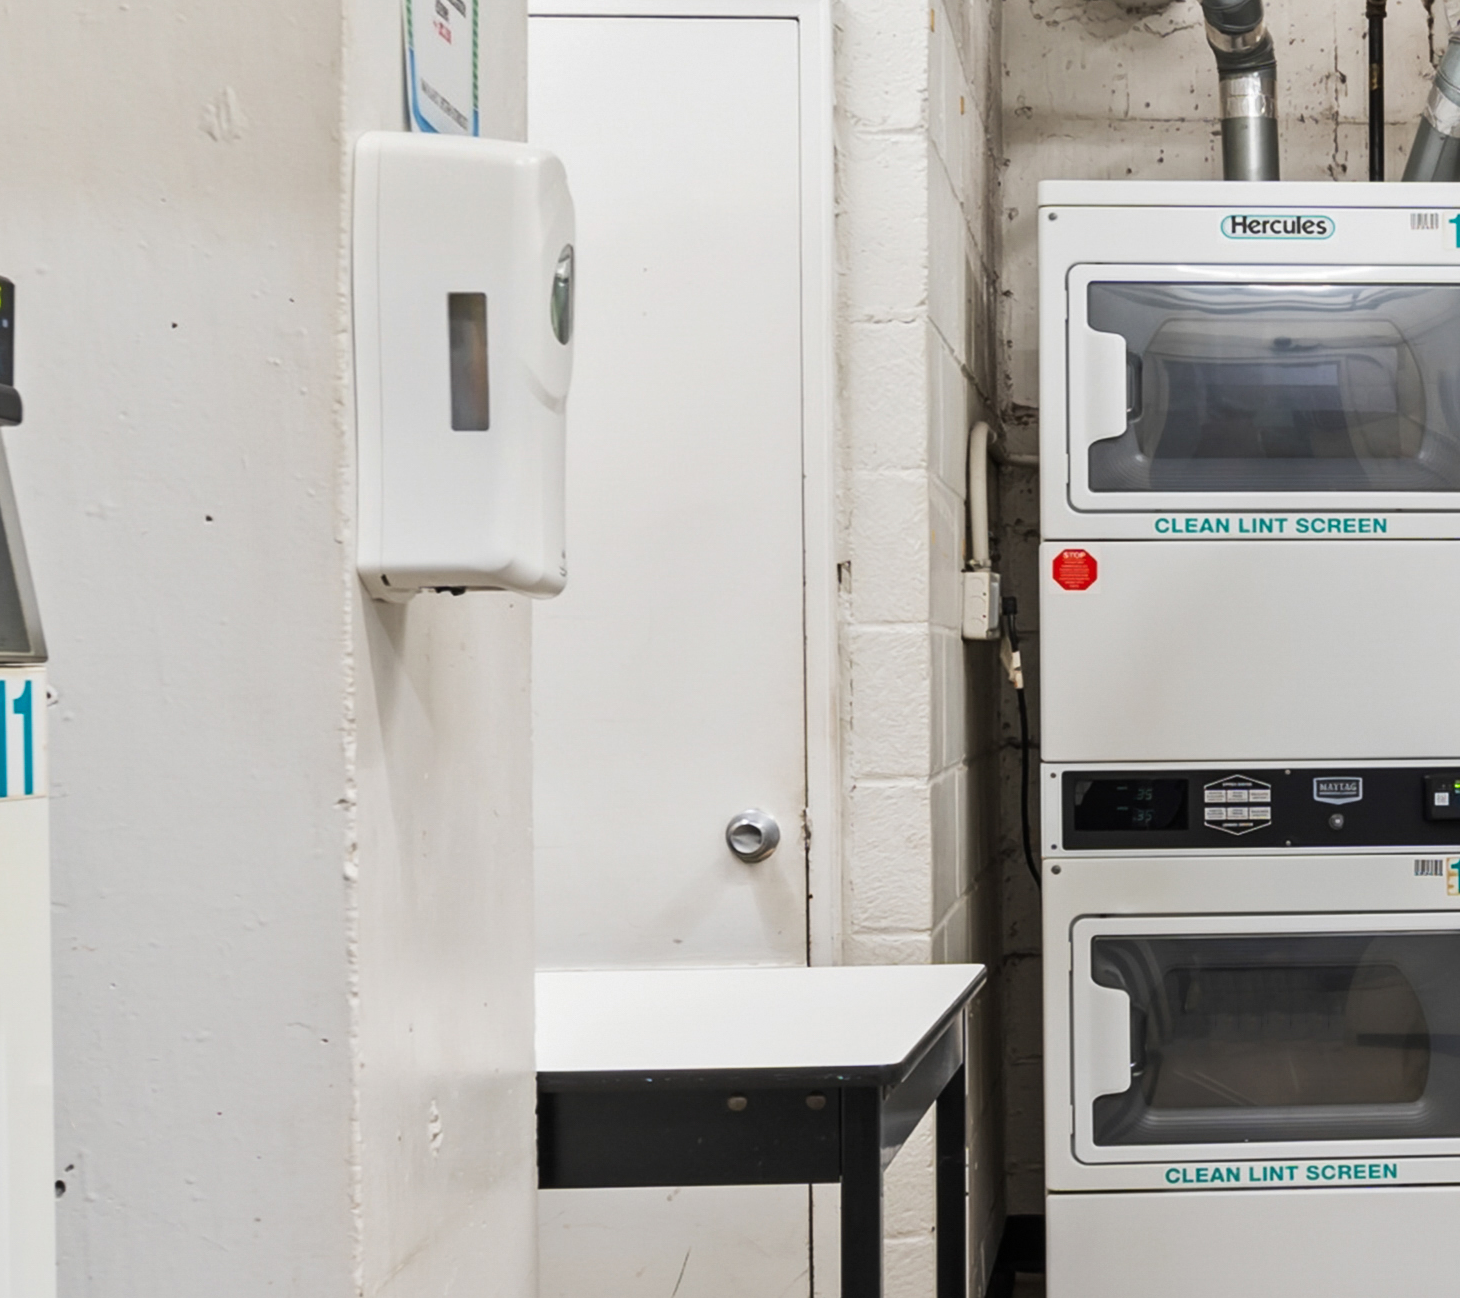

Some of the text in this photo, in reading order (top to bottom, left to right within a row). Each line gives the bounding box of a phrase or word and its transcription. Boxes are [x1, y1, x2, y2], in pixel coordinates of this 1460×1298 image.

[1231, 216, 1327, 235] Hercules
[1154, 518, 1388, 534] CLEAN LINT SCREEN
[1319, 782, 1357, 794] MAYTAG
[1165, 1163, 1398, 1184] CLEAN LINT SCREEN
